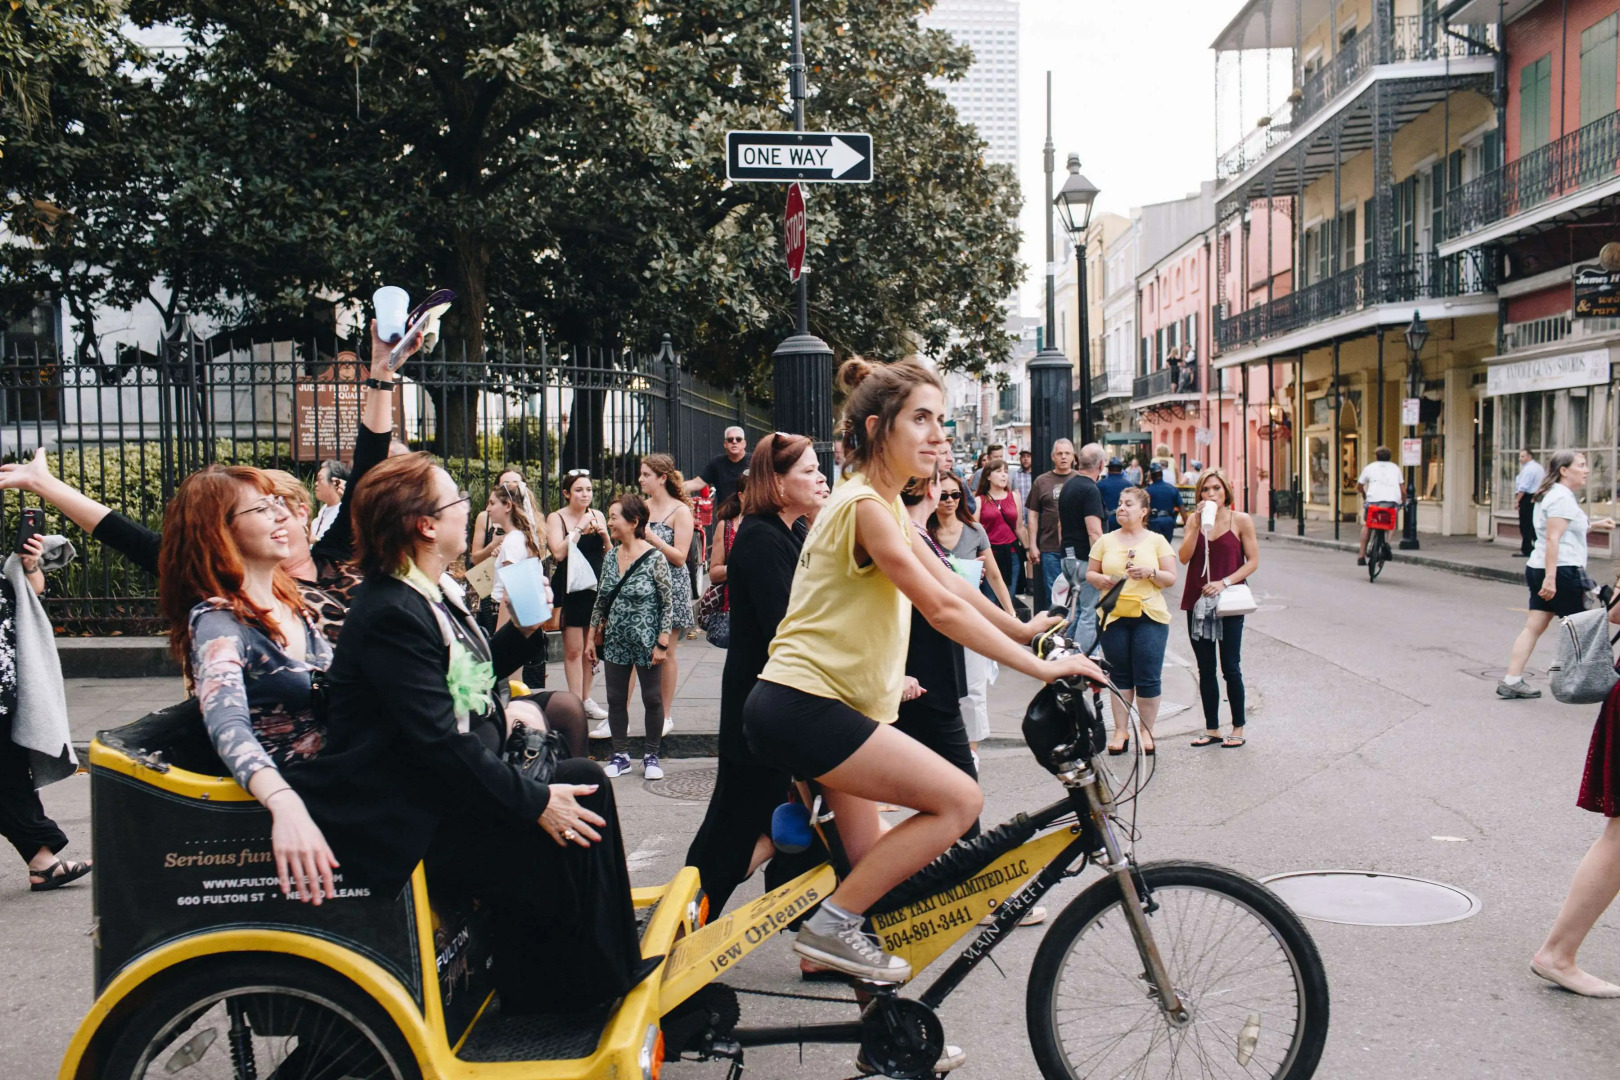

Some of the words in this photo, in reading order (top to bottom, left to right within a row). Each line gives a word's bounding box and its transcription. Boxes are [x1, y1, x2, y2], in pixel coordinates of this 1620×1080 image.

[744, 147, 782, 165] ONE
[789, 148, 829, 166] WAY
[785, 211, 804, 255] STOP
[1576, 273, 1608, 285] James
[1576, 299, 1591, 312] &
[164, 851, 236, 868] Serious
[236, 848, 272, 867] fun
[177, 896, 201, 906] 600
[202, 894, 249, 904] FULTON
[250, 892, 265, 902] ST
[317, 888, 371, 900] OLEANS
[744, 887, 819, 944] Orleans
[876, 908, 908, 930] BIKE
[909, 897, 938, 918] TAXI
[884, 905, 973, 951] 504-891-3441
[435, 926, 469, 973] FULTON
